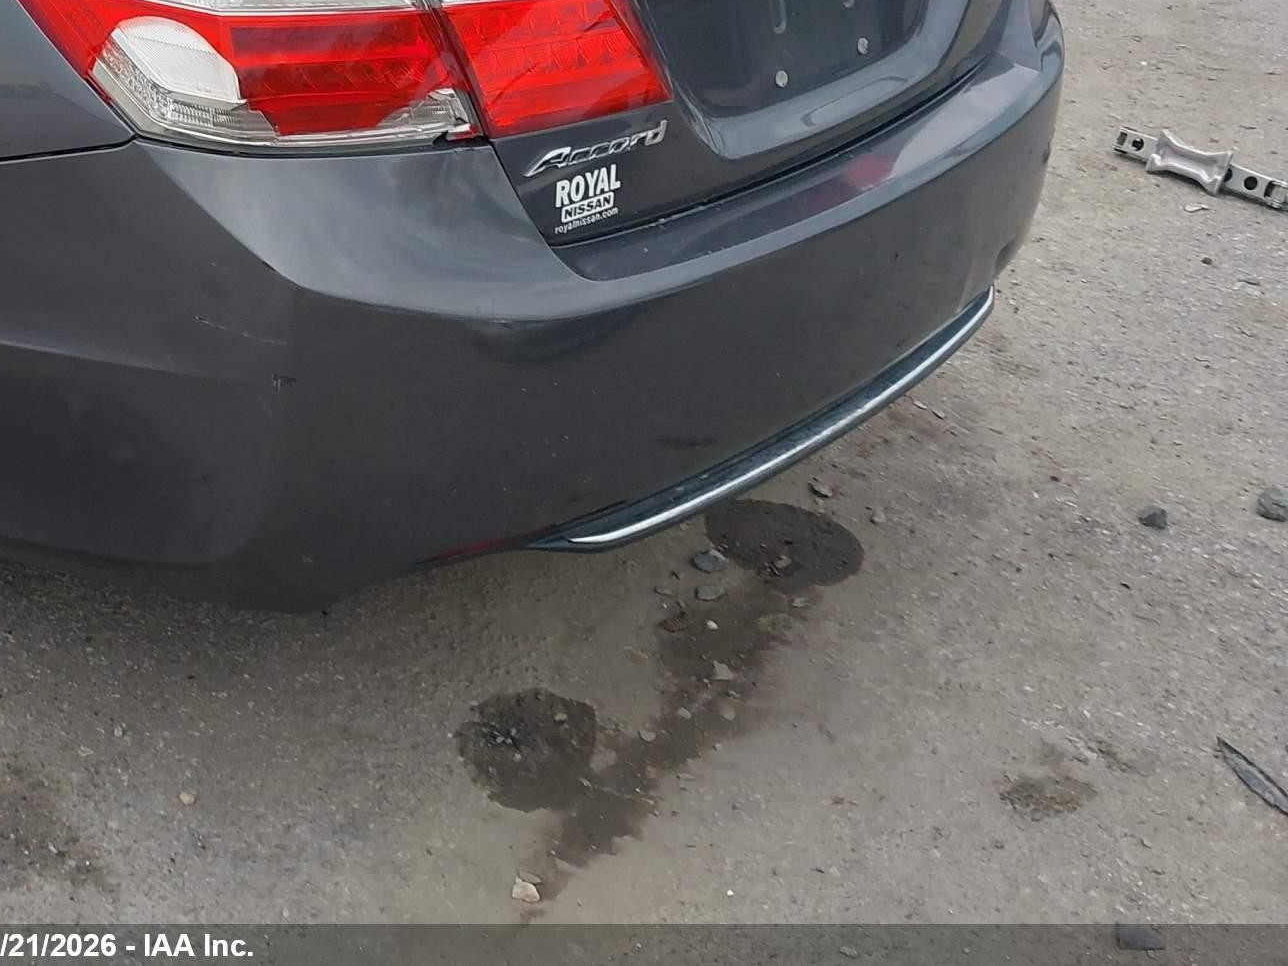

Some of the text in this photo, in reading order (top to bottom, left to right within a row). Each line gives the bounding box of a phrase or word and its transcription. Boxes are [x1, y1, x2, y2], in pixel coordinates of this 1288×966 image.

[523, 120, 668, 177] Accord
[555, 164, 621, 208] ROYAL
[554, 207, 619, 234] royalnissan.com
[563, 194, 612, 220] NISSAN
